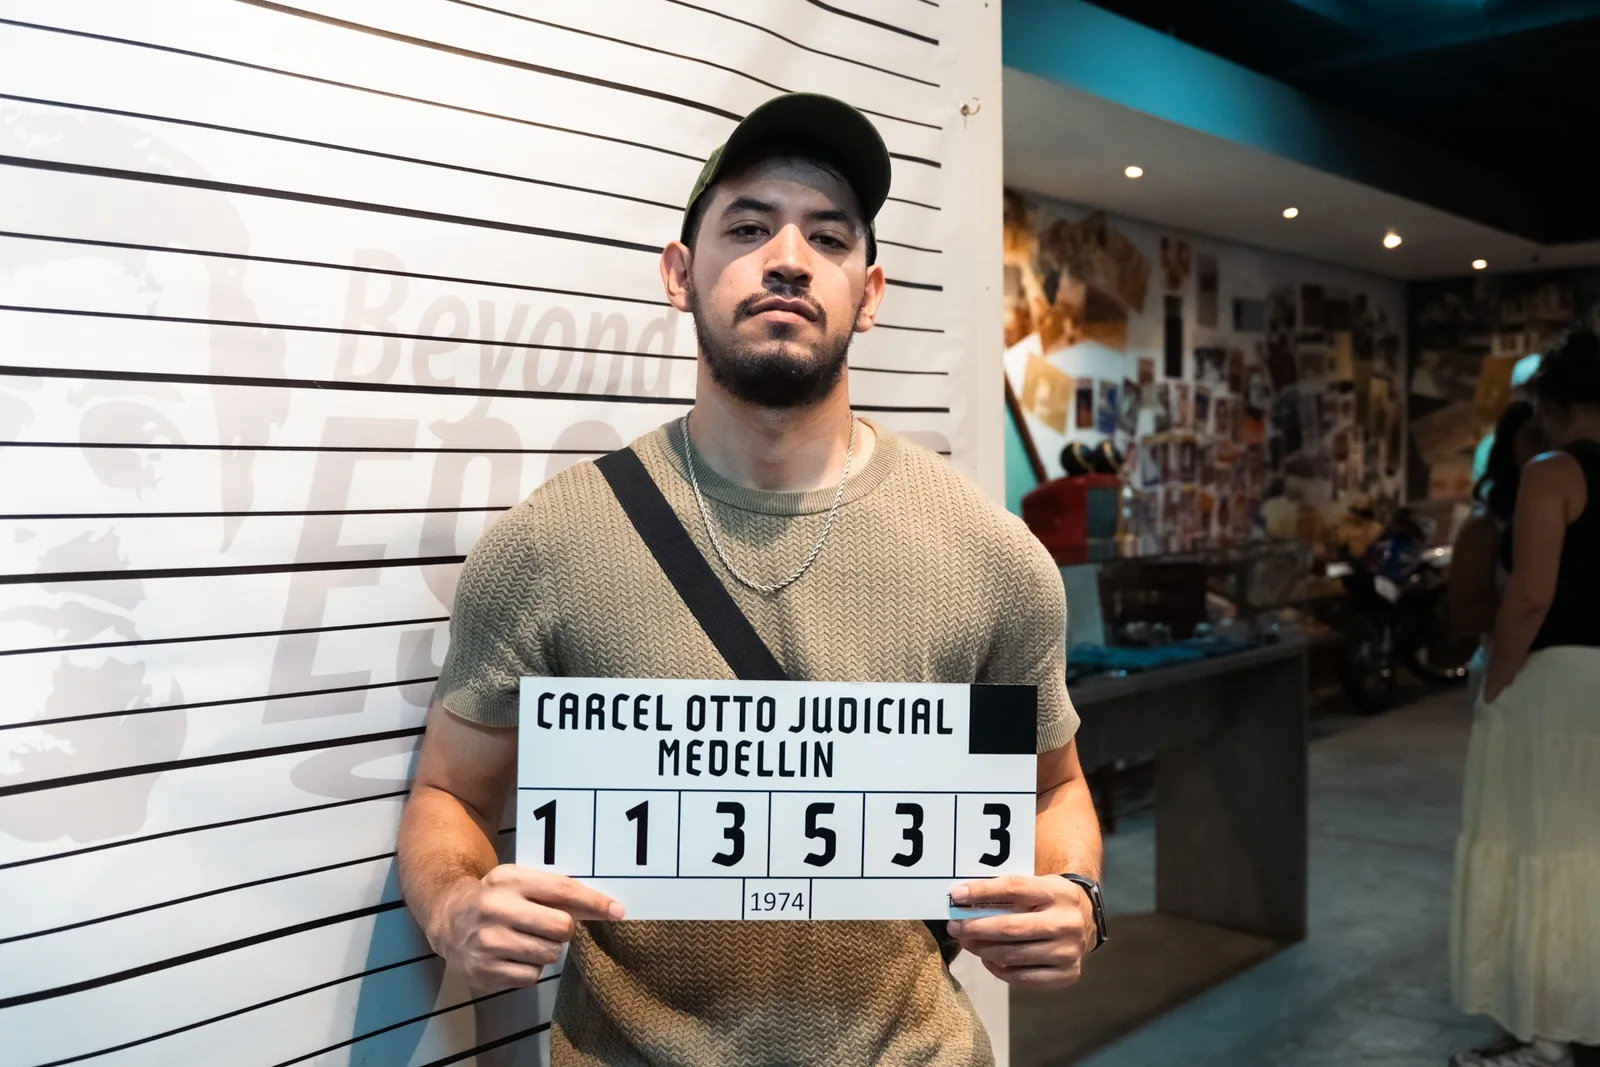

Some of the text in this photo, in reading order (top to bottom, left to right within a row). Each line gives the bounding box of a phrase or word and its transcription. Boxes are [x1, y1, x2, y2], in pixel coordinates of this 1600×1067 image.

[333, 247, 679, 420] Beyond
[536, 691, 954, 736] CARCEL OTTO JUDICIAL
[657, 738, 835, 778] MEDELLIN
[532, 799, 1012, 868] 1 1 3 5 3 3
[750, 892, 805, 912] 1974
